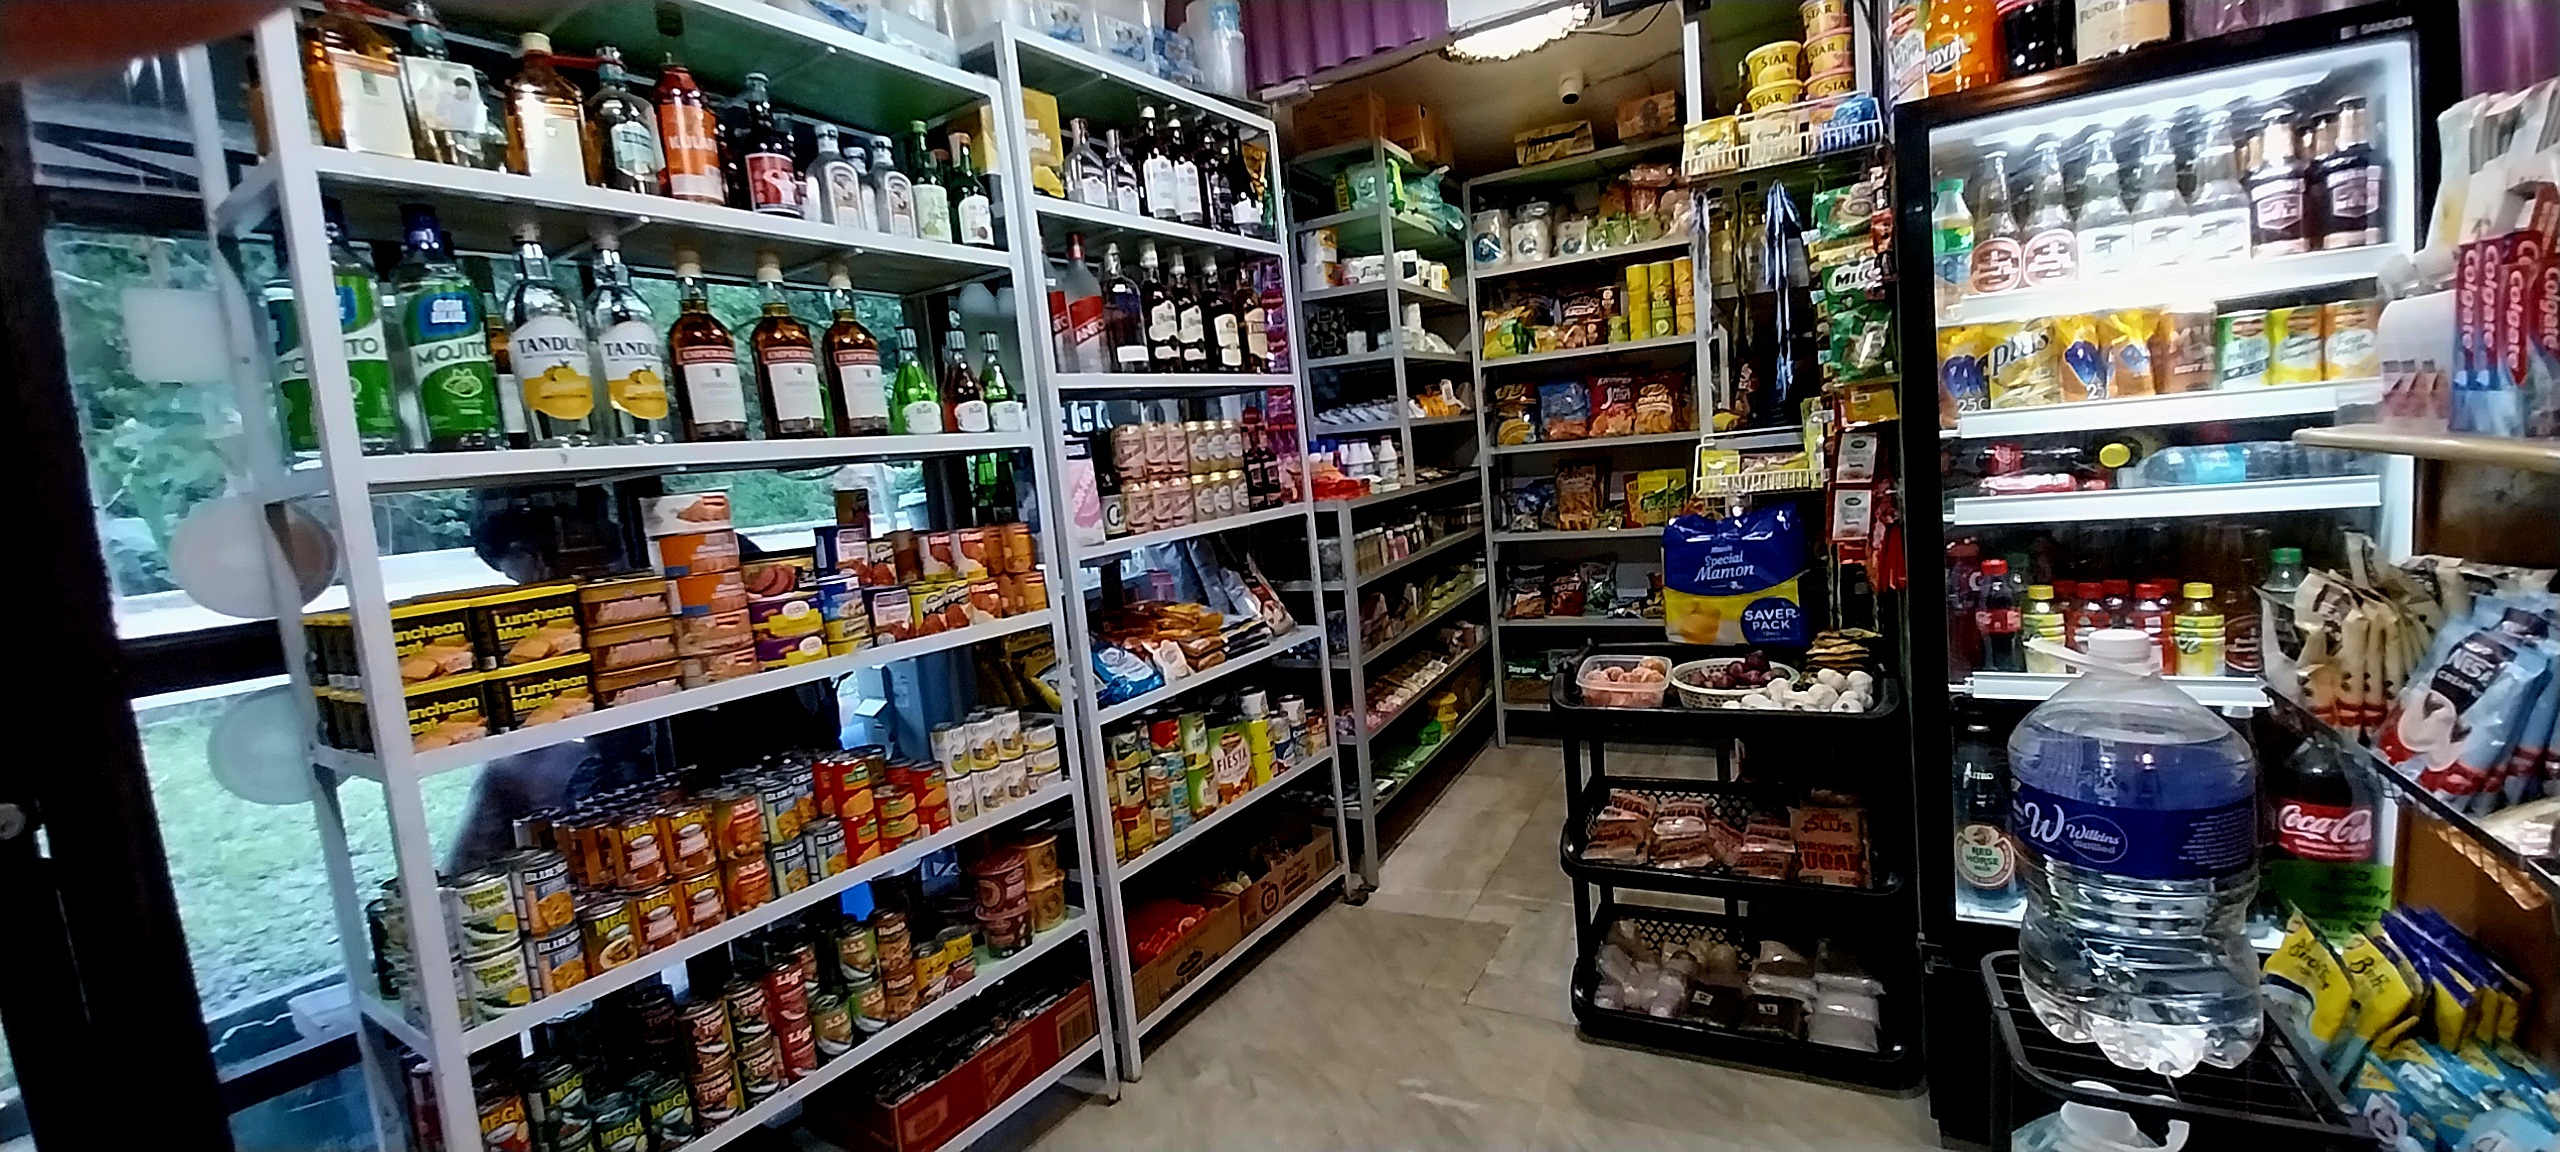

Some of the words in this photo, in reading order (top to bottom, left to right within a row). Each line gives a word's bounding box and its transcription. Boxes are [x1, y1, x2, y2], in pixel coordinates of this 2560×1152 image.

[1805, 4, 1833, 22] STAR
[1809, 41, 1836, 60] STAR
[1760, 53, 1790, 69] STAR
[1754, 92, 1783, 109] STAR
[1075, 318, 1106, 344] ANTO
[517, 336, 586, 353] TANDUA
[604, 342, 662, 356] TANDU
[1991, 330, 2050, 377] plus
[1704, 550, 1744, 568] Special
[1694, 565, 1756, 582] Mamon
[494, 605, 575, 628] Luncheon
[1744, 608, 1797, 621] SAVER
[394, 621, 466, 642] ncheon
[498, 624, 539, 641] Meat
[1752, 620, 1791, 631] PACK
[396, 641, 425, 656] eat
[509, 674, 588, 697] Luncheon
[408, 696, 479, 719] ncheon
[512, 693, 554, 712] Meat
[410, 717, 439, 735] eat
[1216, 748, 1249, 773] FIESTA
[1612, 799, 1650, 819] UGAR
[670, 809, 706, 832] MEGA
[2024, 802, 2065, 843] W
[621, 821, 658, 844] MEGA
[2066, 824, 2122, 845] Wilkins
[1966, 854, 1999, 866] HORSE
[1972, 847, 1993, 856] RED
[639, 891, 675, 916] MEGA
[548, 1073, 584, 1106] MEG
[651, 1085, 690, 1116] MEGA
[600, 1115, 645, 1149] MEGA
